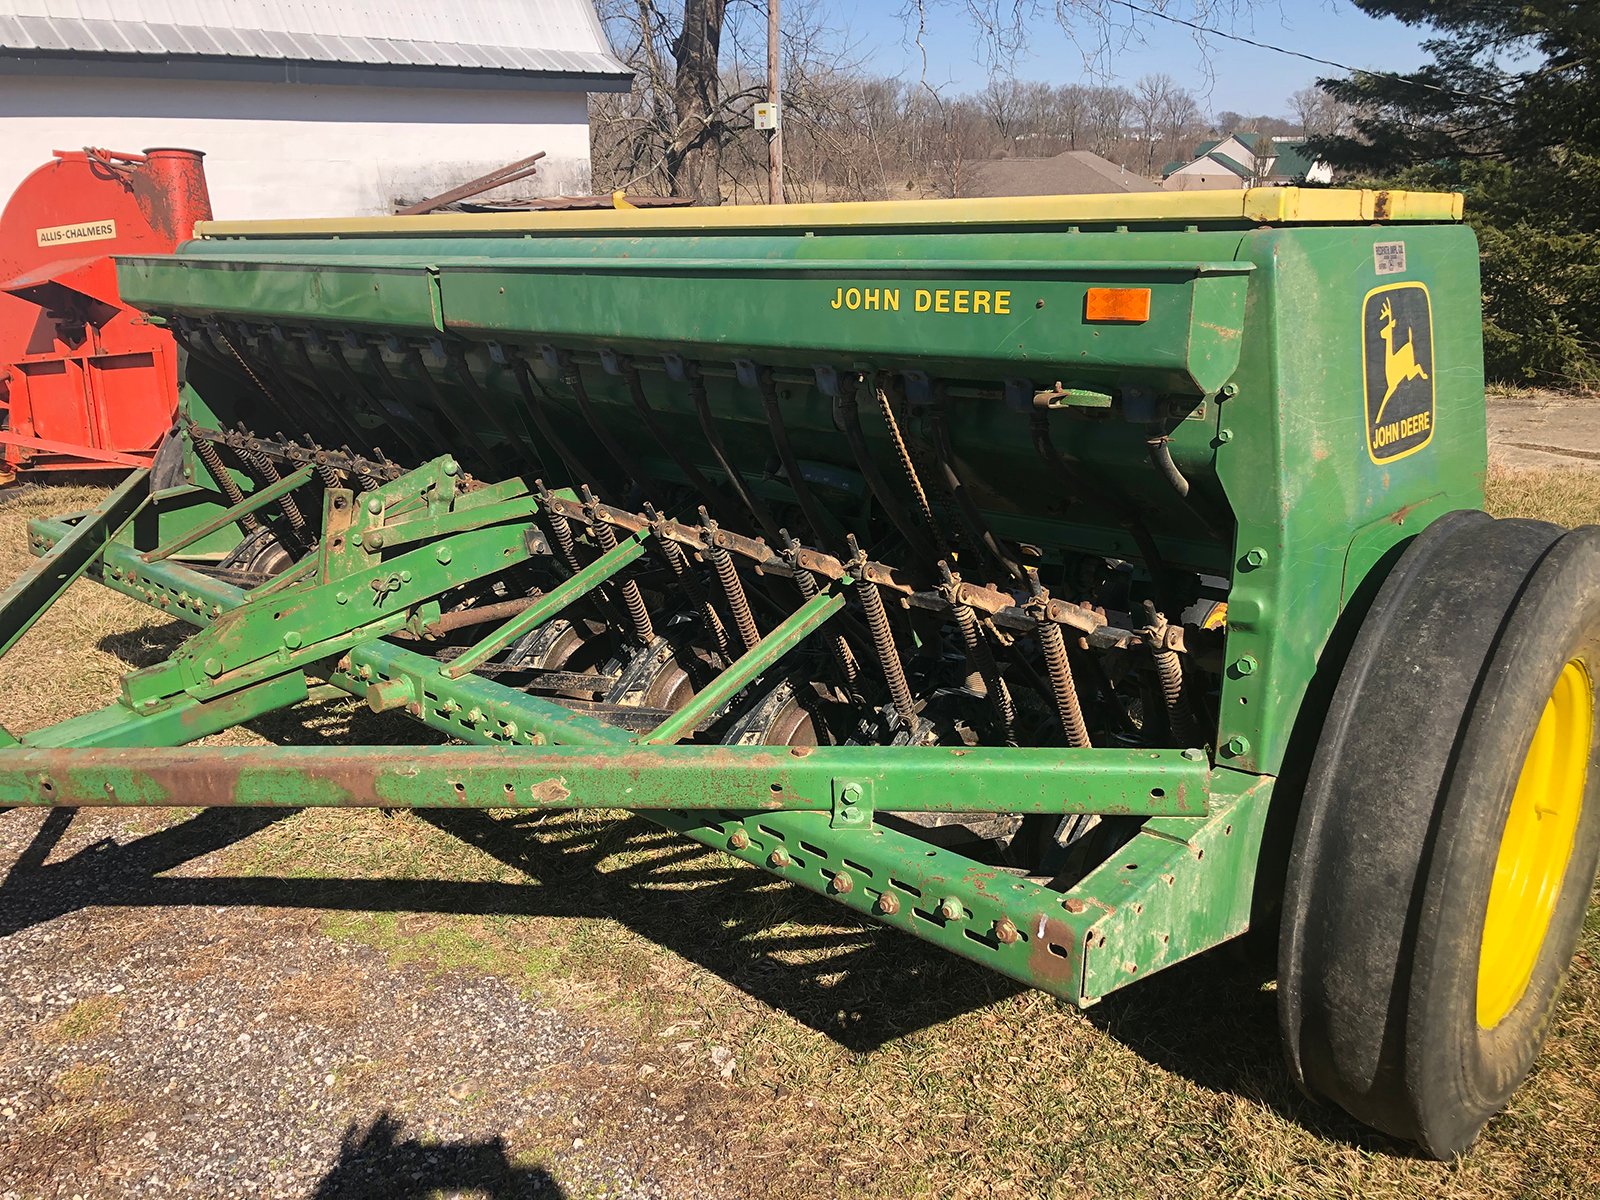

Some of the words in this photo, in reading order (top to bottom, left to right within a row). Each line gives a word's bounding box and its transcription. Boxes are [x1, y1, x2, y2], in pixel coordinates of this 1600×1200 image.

[40, 224, 113, 242] ALLIS-CHALMERS
[830, 287, 900, 311] JOHN
[914, 289, 1011, 314] DEERE
[1372, 421, 1399, 449] JOHN
[1400, 410, 1430, 439] DEERE
